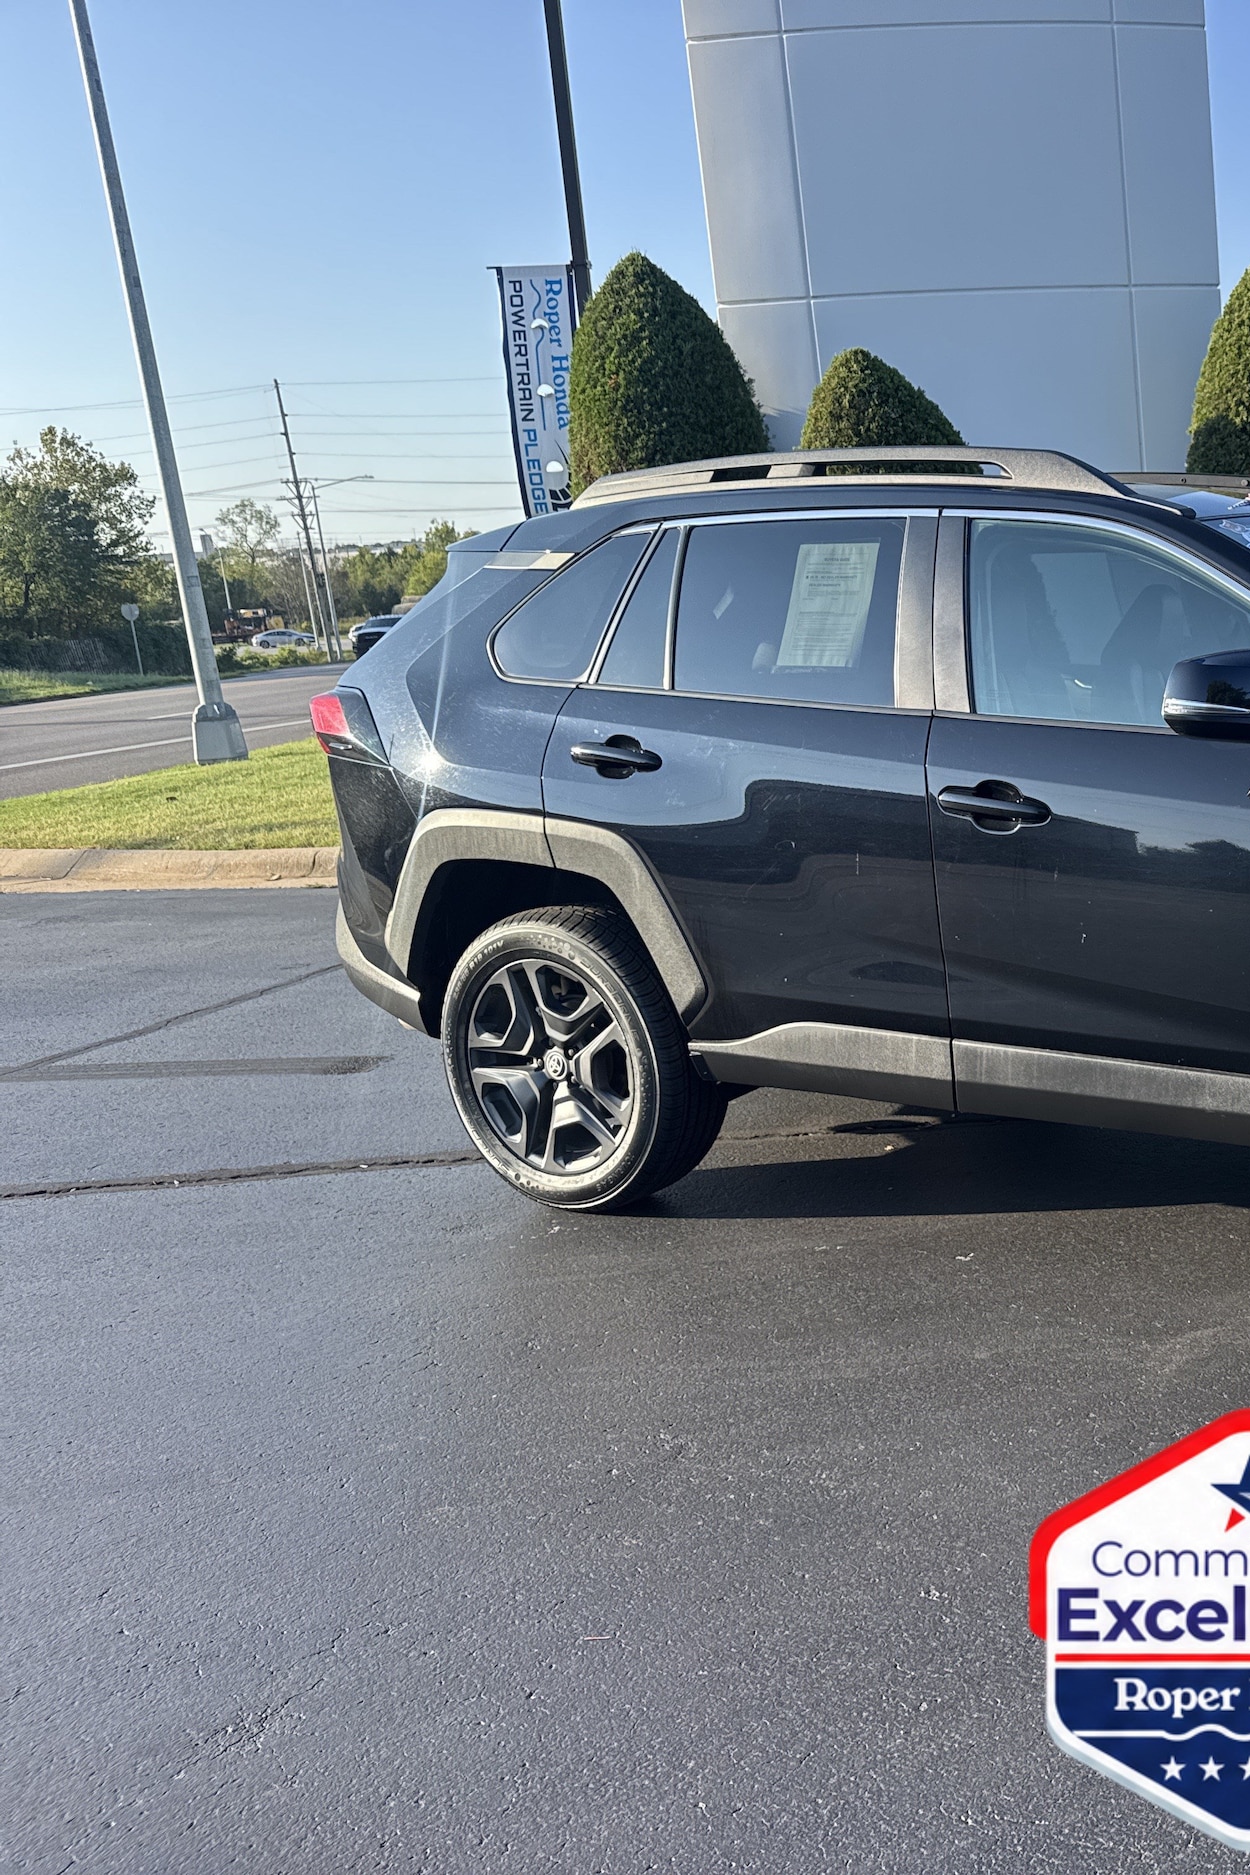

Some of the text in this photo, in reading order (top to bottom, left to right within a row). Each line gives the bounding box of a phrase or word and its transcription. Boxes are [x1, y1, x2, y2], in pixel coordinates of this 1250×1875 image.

[543, 278, 563, 348] Roper
[508, 280, 550, 514] POWERTRAIN PLEDGE
